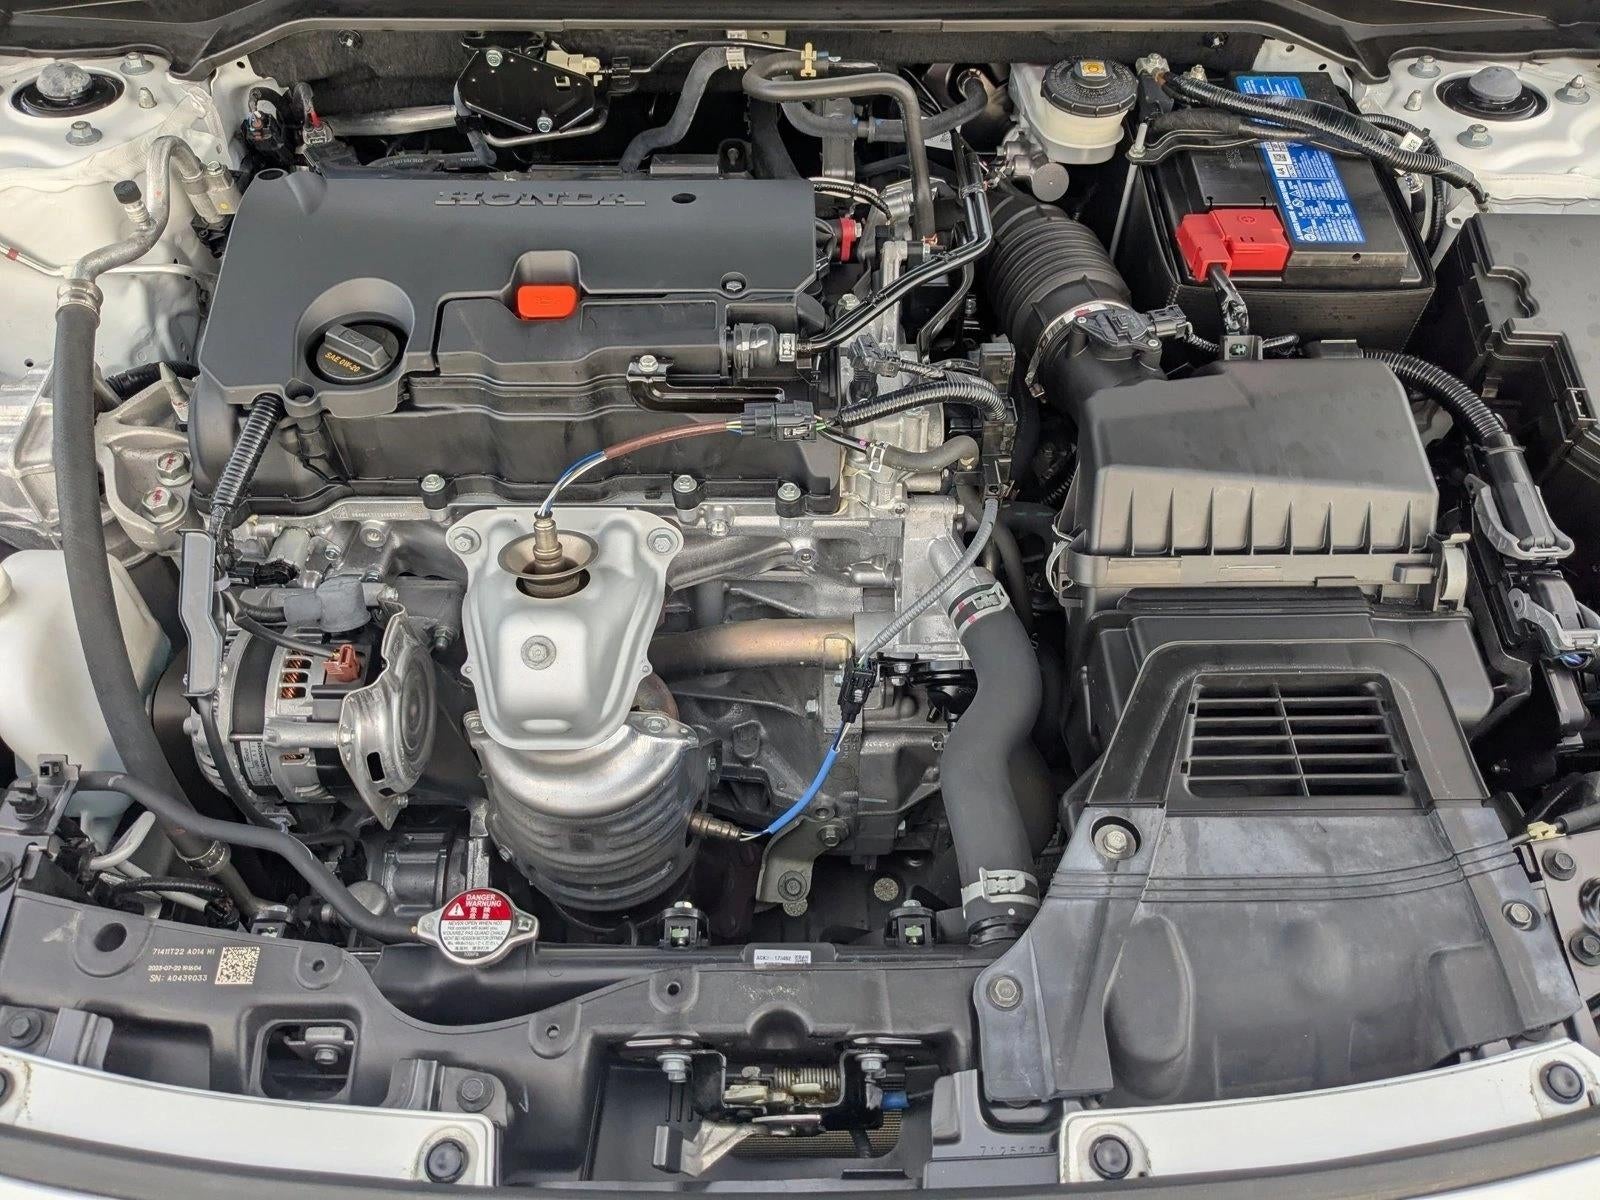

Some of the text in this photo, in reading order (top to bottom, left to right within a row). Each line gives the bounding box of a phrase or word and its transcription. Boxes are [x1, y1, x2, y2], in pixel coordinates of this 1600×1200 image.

[434, 191, 647, 207] HONDA
[324, 352, 361, 373] SAE 0W-20
[152, 948, 185, 956] 71411T22
[187, 948, 205, 956] A014
[149, 974, 208, 982] SN: A0439033
